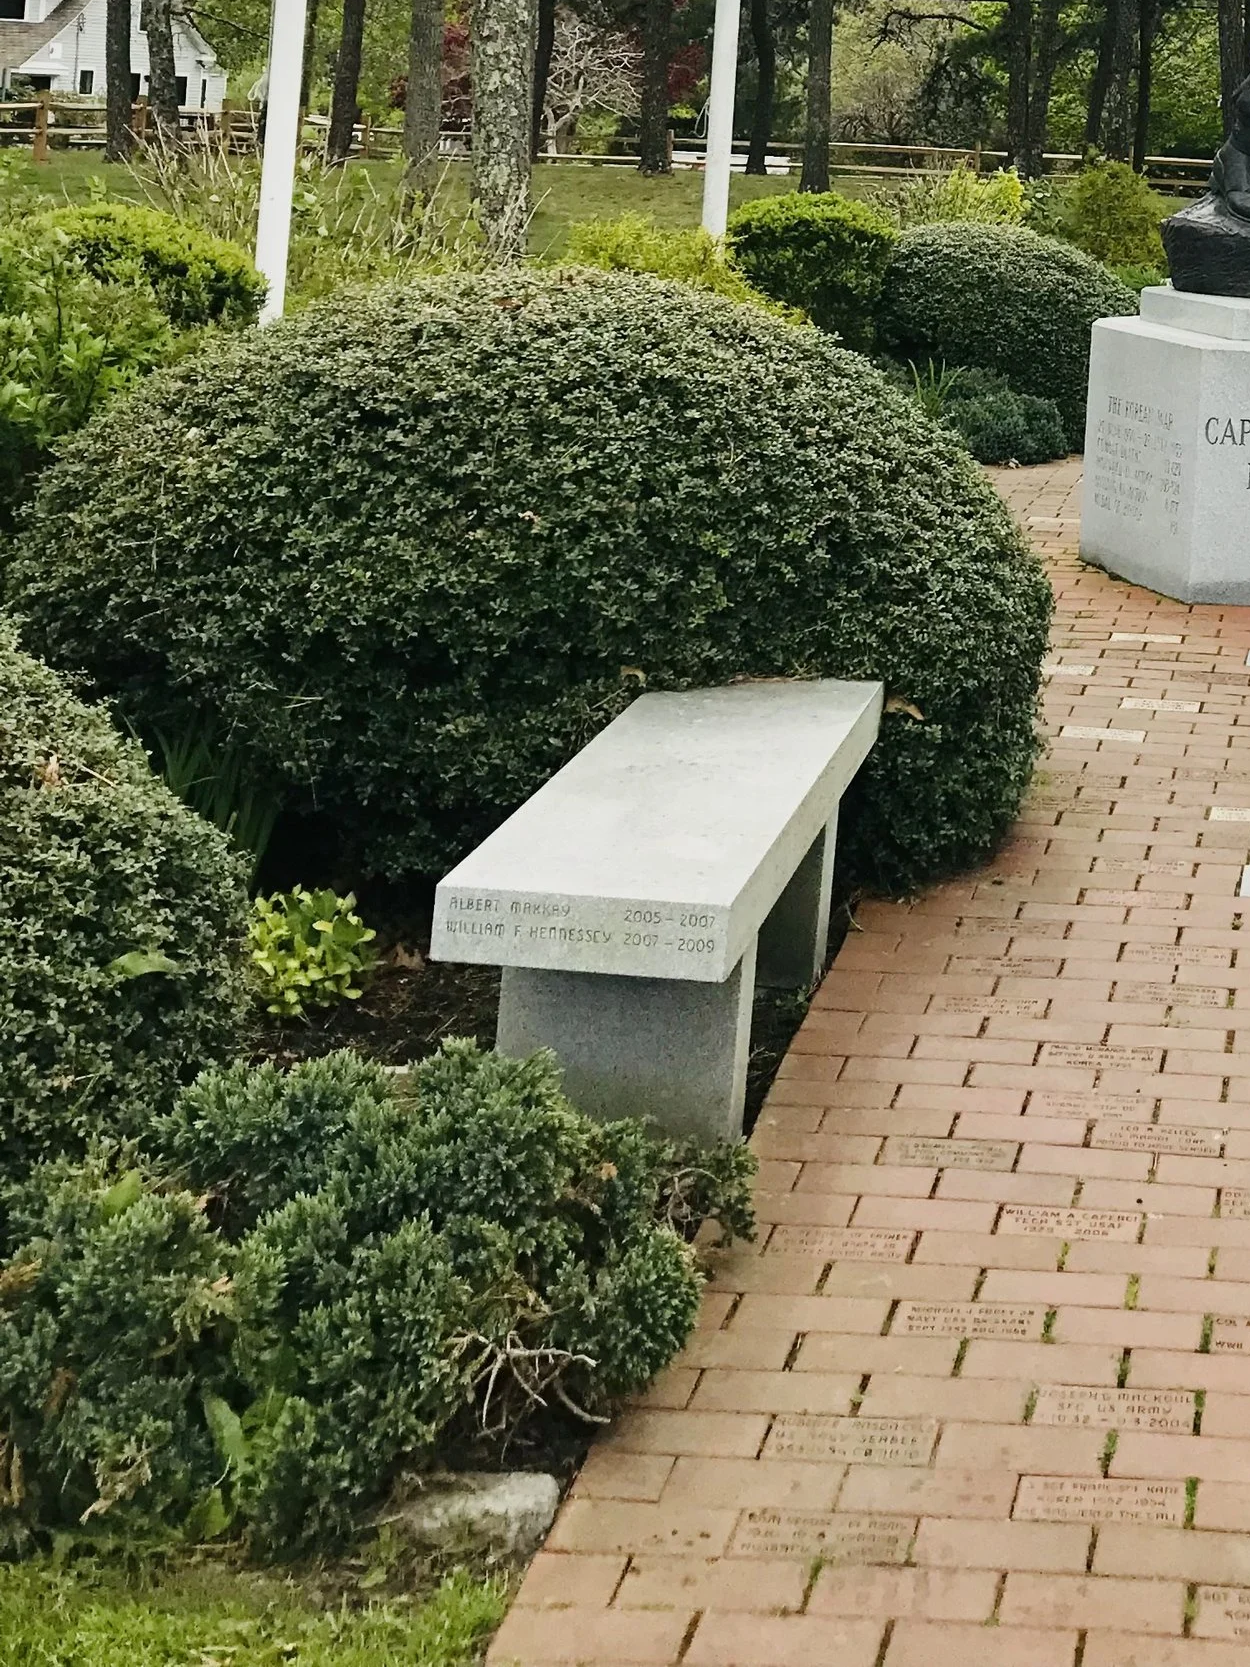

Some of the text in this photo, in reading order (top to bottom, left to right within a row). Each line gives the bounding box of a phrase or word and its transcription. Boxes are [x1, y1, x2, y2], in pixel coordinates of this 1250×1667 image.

[449, 896, 499, 912] ALBERT
[623, 909, 662, 924] 2005
[679, 913, 716, 929] 2007
[446, 919, 505, 938] WILLIAM
[623, 932, 660, 947] 2007
[677, 937, 716, 953] 2009
[1215, 1340, 1244, 1350] WWII
